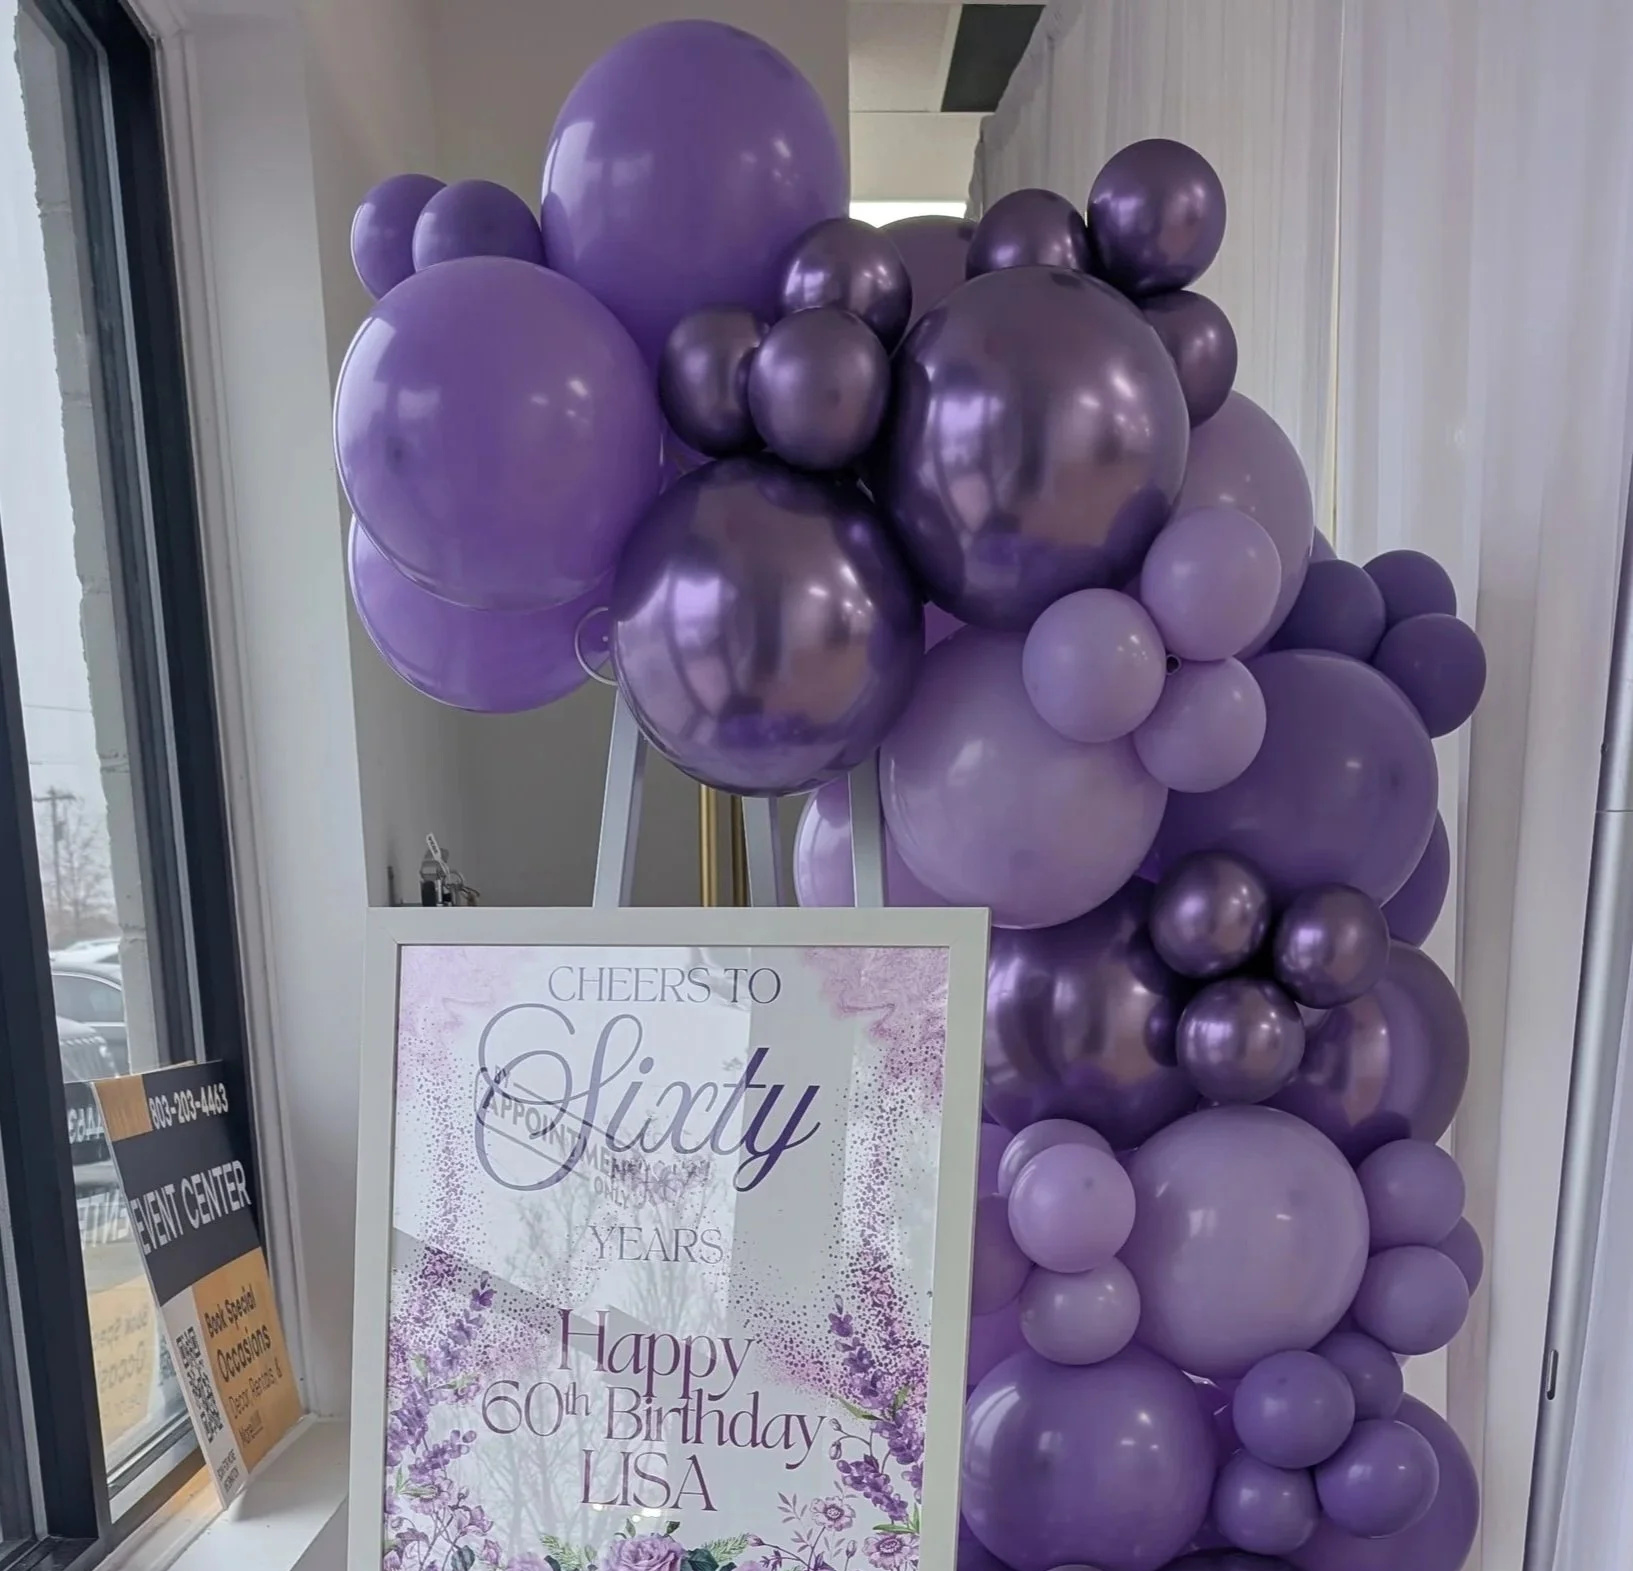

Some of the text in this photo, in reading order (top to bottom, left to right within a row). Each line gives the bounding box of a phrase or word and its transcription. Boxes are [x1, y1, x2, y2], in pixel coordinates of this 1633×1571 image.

[548, 965, 781, 1004] CHEERS TO
[148, 1082, 229, 1130] 803-203-4463
[474, 1002, 821, 1193] Sixty
[128, 1160, 252, 1256] EVENT CENTER
[588, 1225, 724, 1265] YEARS
[204, 1282, 257, 1339] Book Special
[216, 1324, 272, 1384] Occasions
[557, 1307, 755, 1401] Happy
[481, 1379, 828, 1471] 60th Birthday
[580, 1448, 719, 1513] LISA
